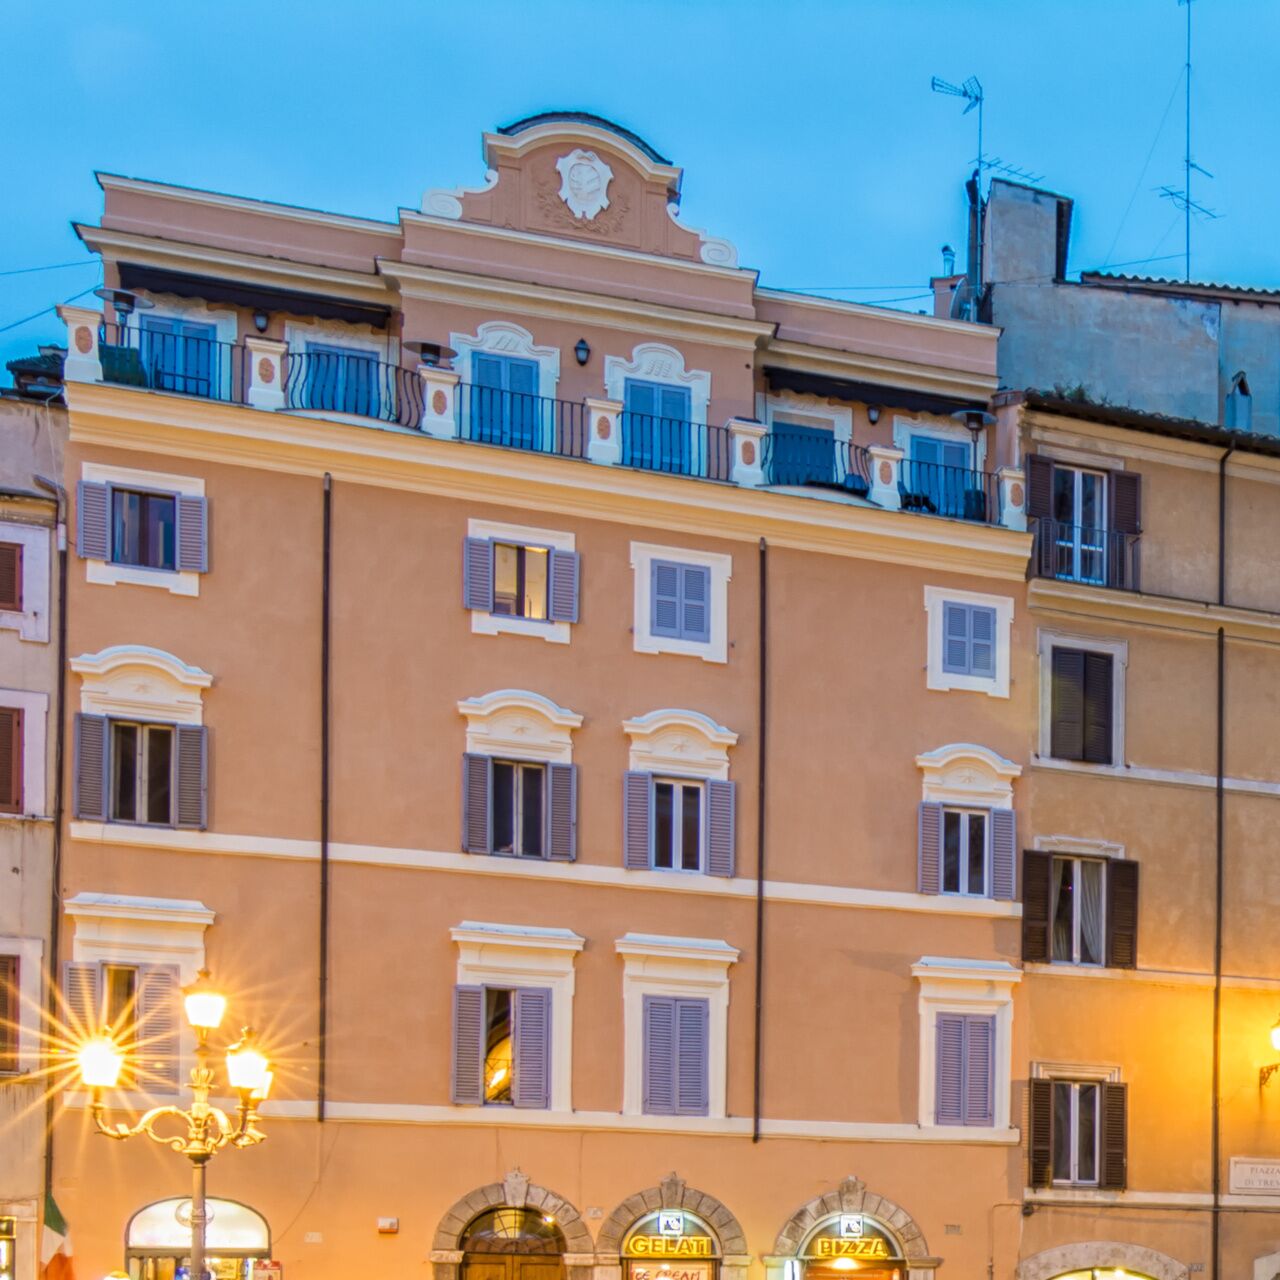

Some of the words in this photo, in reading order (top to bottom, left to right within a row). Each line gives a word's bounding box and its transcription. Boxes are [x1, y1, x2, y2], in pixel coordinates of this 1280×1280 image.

[1250, 1166, 1280, 1175] PIAZZA
[629, 1235, 712, 1255] GELATI
[818, 1237, 888, 1257] PIZZA
